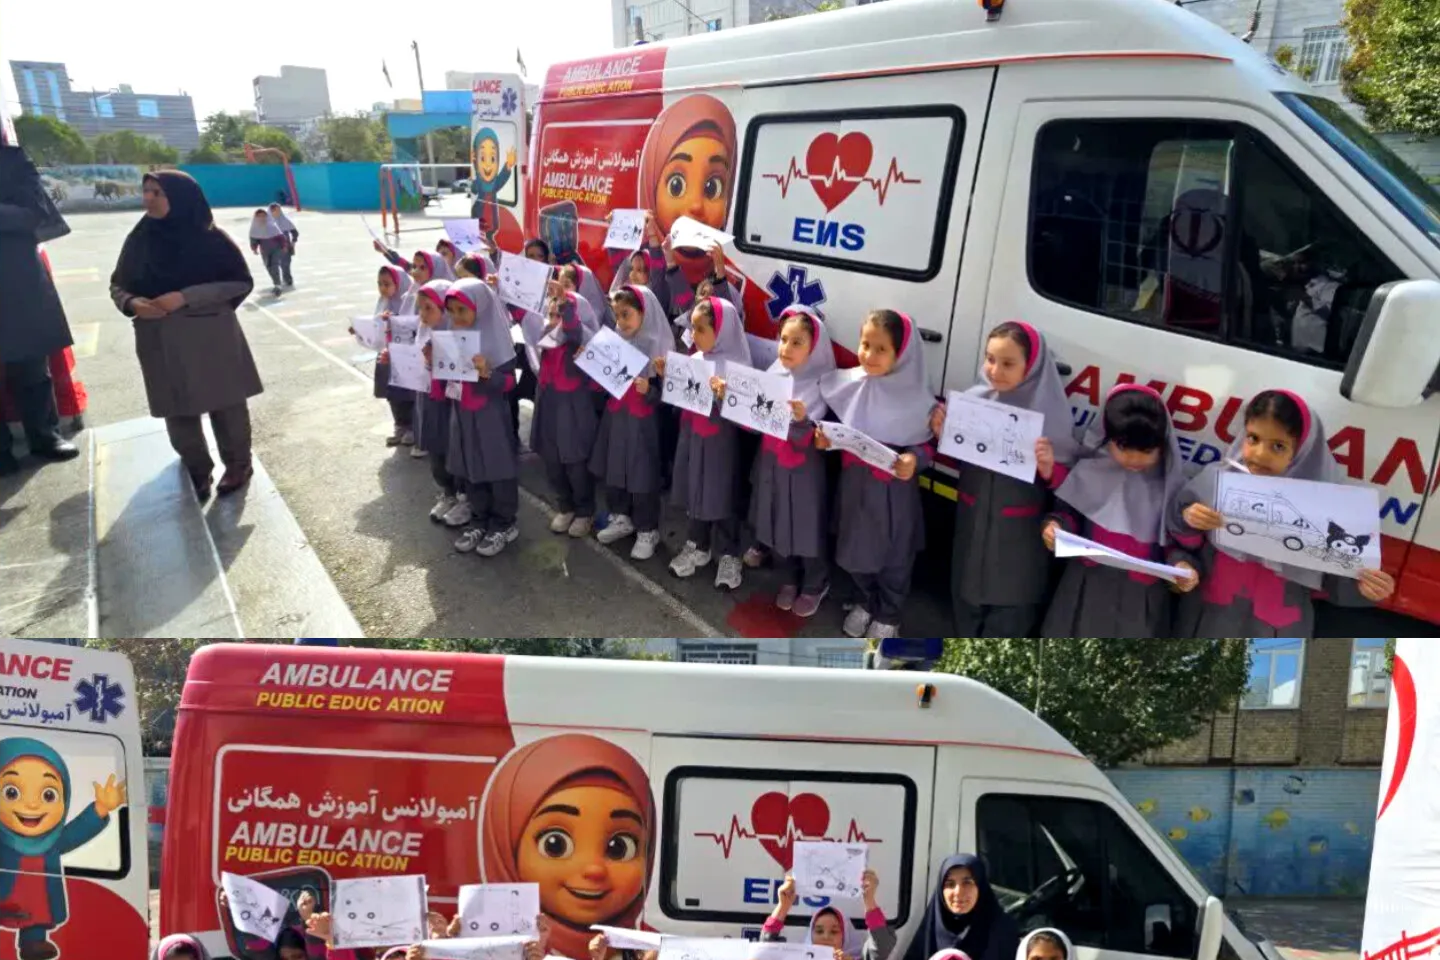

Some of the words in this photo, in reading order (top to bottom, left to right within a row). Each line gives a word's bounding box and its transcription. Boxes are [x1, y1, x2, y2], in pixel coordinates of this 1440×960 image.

[563, 57, 642, 80] AMBULANCE
[543, 148, 569, 167] همگانی
[570, 148, 598, 169] آموزش
[598, 150, 641, 172] آمبولانس
[543, 172, 614, 195] AMBULANCE
[260, 662, 453, 692] AMBULANCE
[0, 703, 72, 723] آمبولانس
[257, 692, 325, 709] PUBLIC
[329, 694, 382, 711] EDUC
[386, 697, 444, 714] ATION
[227, 786, 300, 812] همگانی
[307, 789, 379, 819] آموزش
[382, 796, 477, 824] آمبولانس
[229, 821, 423, 856] AMBULANCE
[224, 846, 293, 864] PUBLIC
